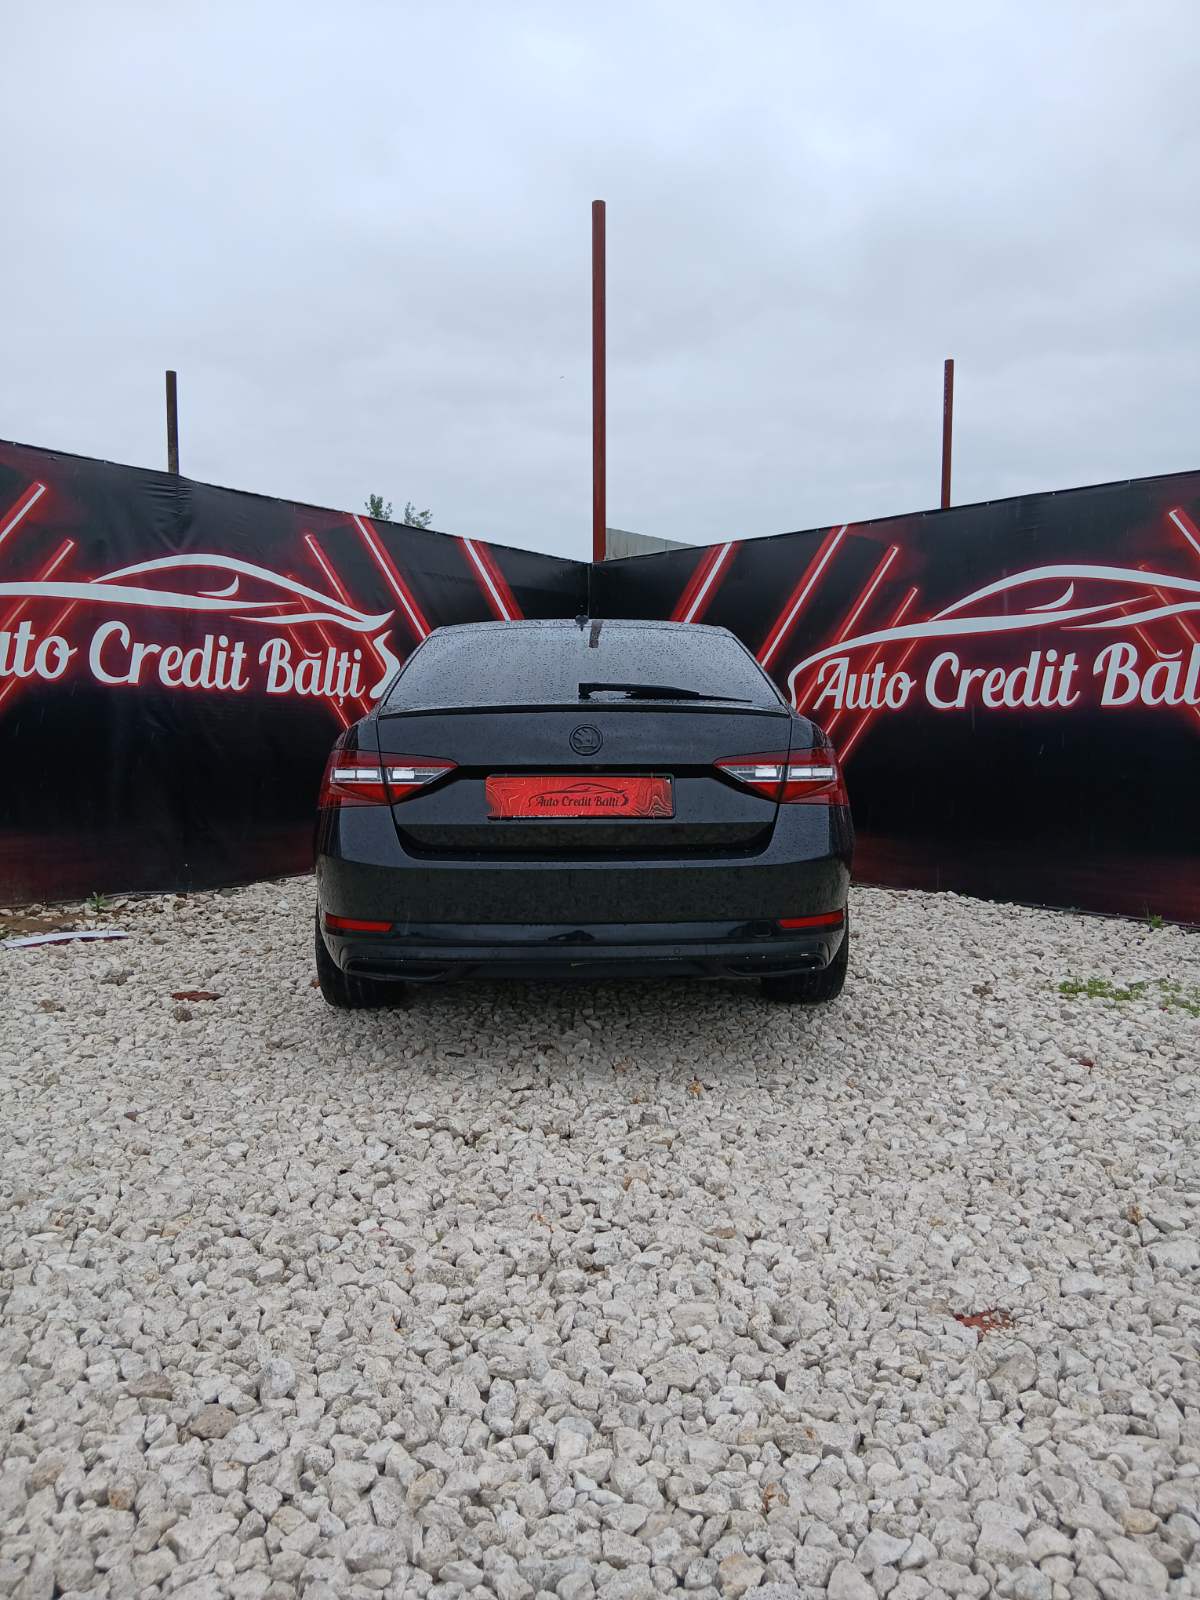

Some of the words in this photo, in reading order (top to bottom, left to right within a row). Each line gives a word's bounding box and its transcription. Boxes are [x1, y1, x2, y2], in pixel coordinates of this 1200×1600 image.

[89, 620, 250, 691] Credit
[258, 637, 366, 707] Bălți
[812, 656, 917, 709] Auto
[925, 649, 1081, 709] Credit
[537, 796, 559, 807] Auto
[561, 796, 592, 807] Credit
